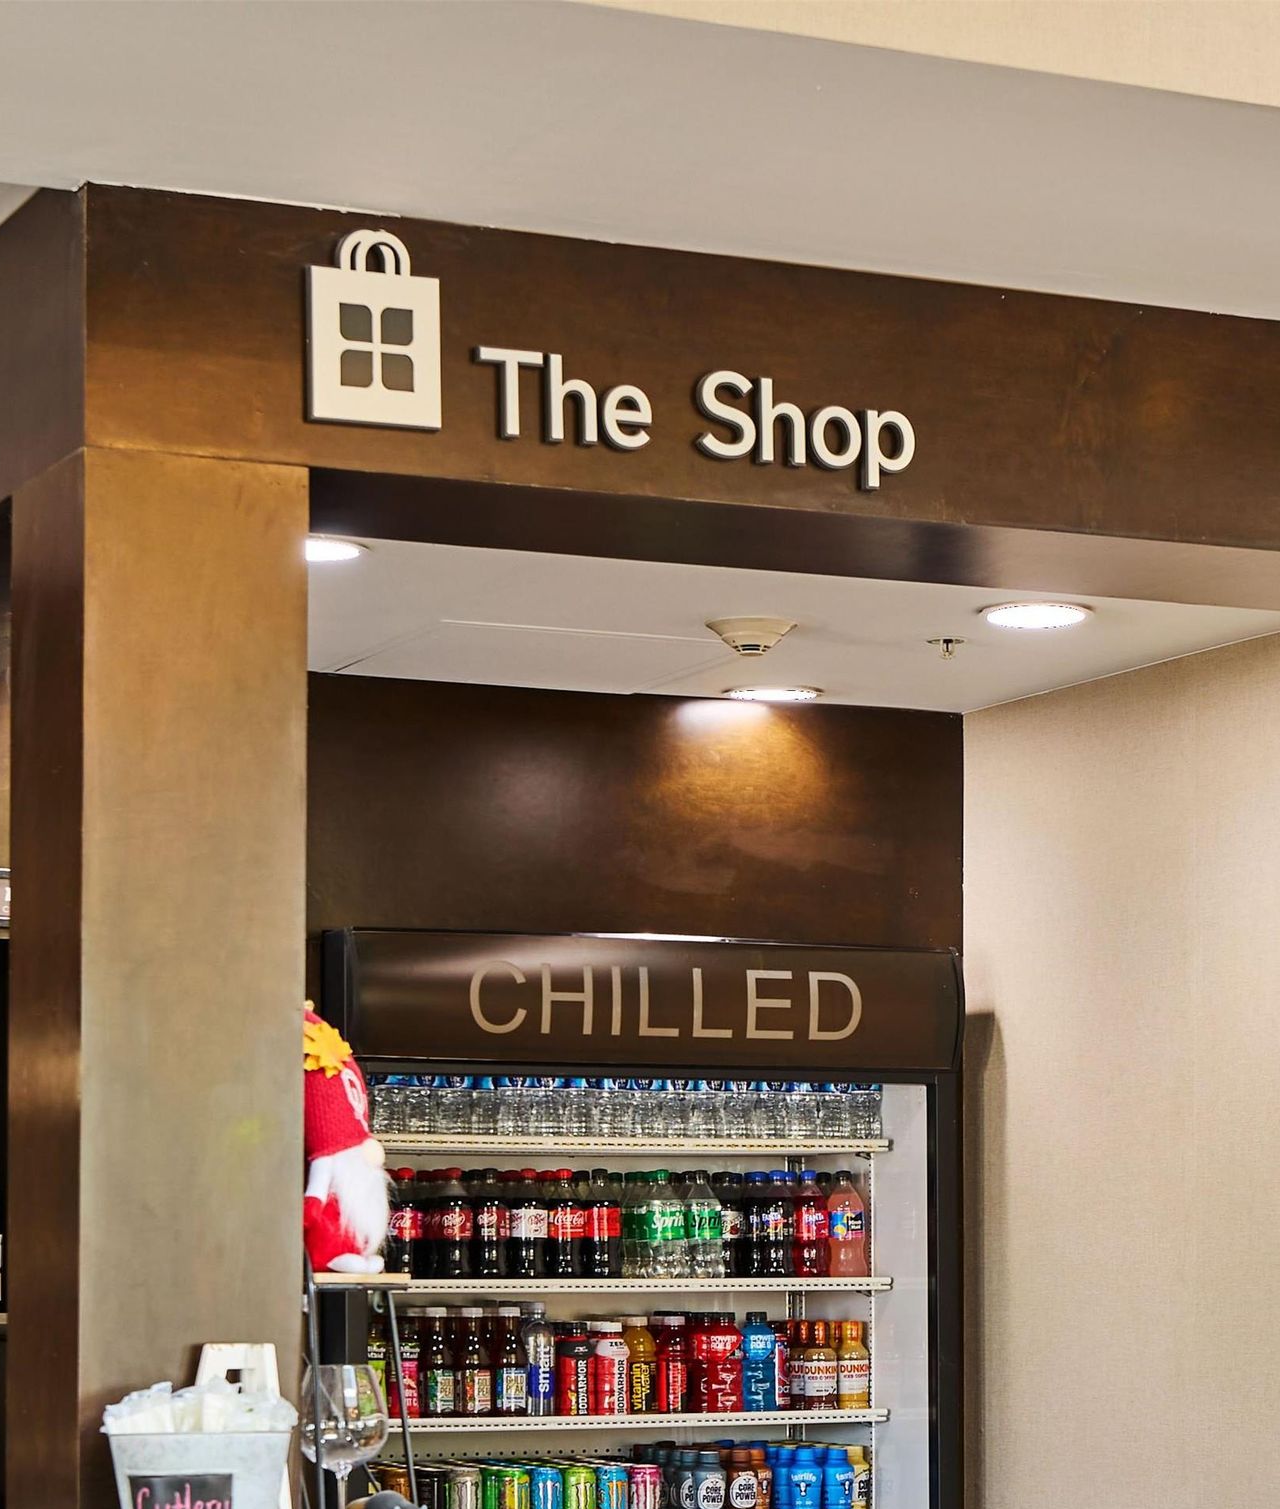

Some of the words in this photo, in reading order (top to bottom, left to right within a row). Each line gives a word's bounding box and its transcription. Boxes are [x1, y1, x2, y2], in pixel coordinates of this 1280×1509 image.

[475, 345, 653, 451] The
[695, 369, 917, 491] Shop
[468, 960, 863, 1042] CHILLED
[577, 1359, 588, 1415] BODYARMOR
[616, 1359, 626, 1415] BODYARMOR
[630, 1363, 642, 1410] vitamin
[705, 1486, 722, 1495] CORE
[738, 1483, 755, 1491] CORE
